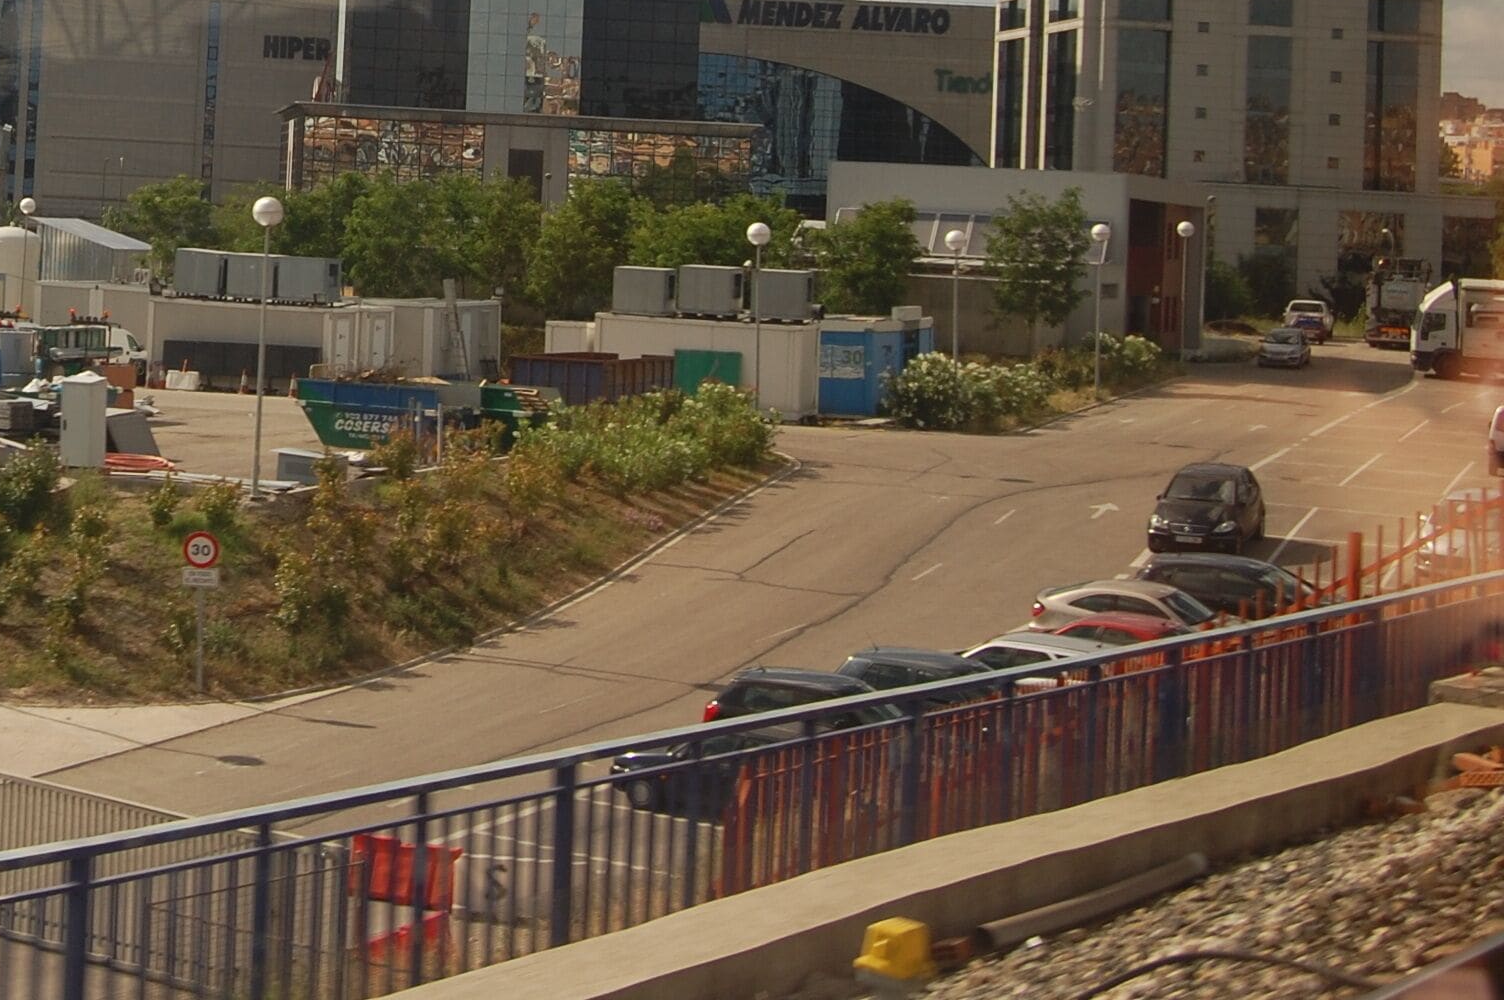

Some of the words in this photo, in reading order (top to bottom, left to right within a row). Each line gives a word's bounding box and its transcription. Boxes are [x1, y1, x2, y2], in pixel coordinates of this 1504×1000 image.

[737, 0, 844, 29] MENDEZ
[852, 5, 950, 34] ALVARO
[263, 35, 332, 60] HIPER
[190, 543, 212, 556] 30
